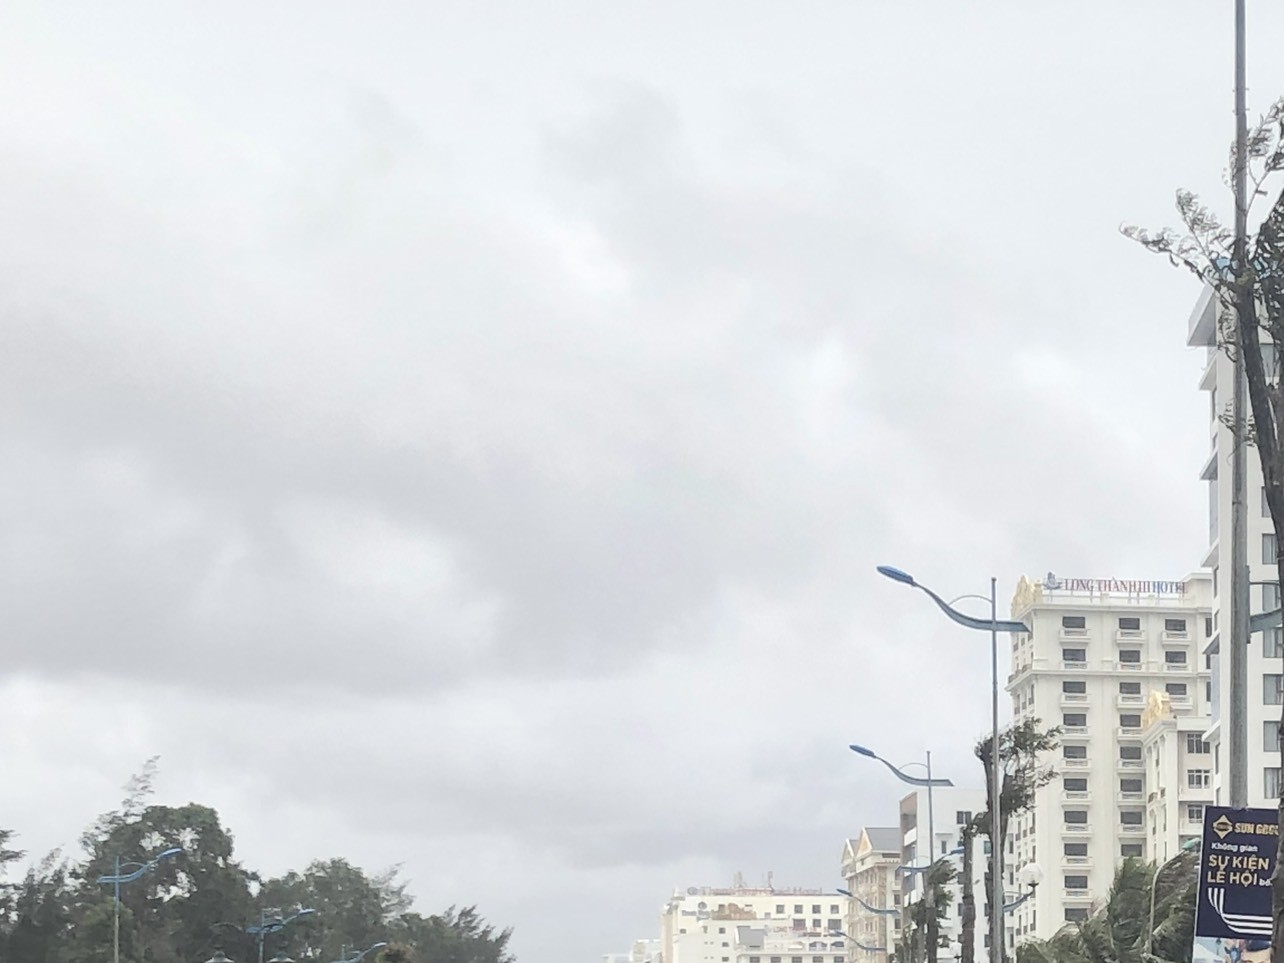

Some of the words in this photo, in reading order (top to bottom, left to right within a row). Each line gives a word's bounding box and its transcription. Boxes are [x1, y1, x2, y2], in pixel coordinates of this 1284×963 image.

[1064, 578, 1094, 591] LONG
[1235, 822, 1254, 834] SUN
[1256, 824, 1279, 835] GRO
[1211, 842, 1239, 852] Không
[1208, 854, 1229, 871] SỰ
[1232, 854, 1270, 872] KIỆN
[1230, 870, 1257, 888] HỘI
